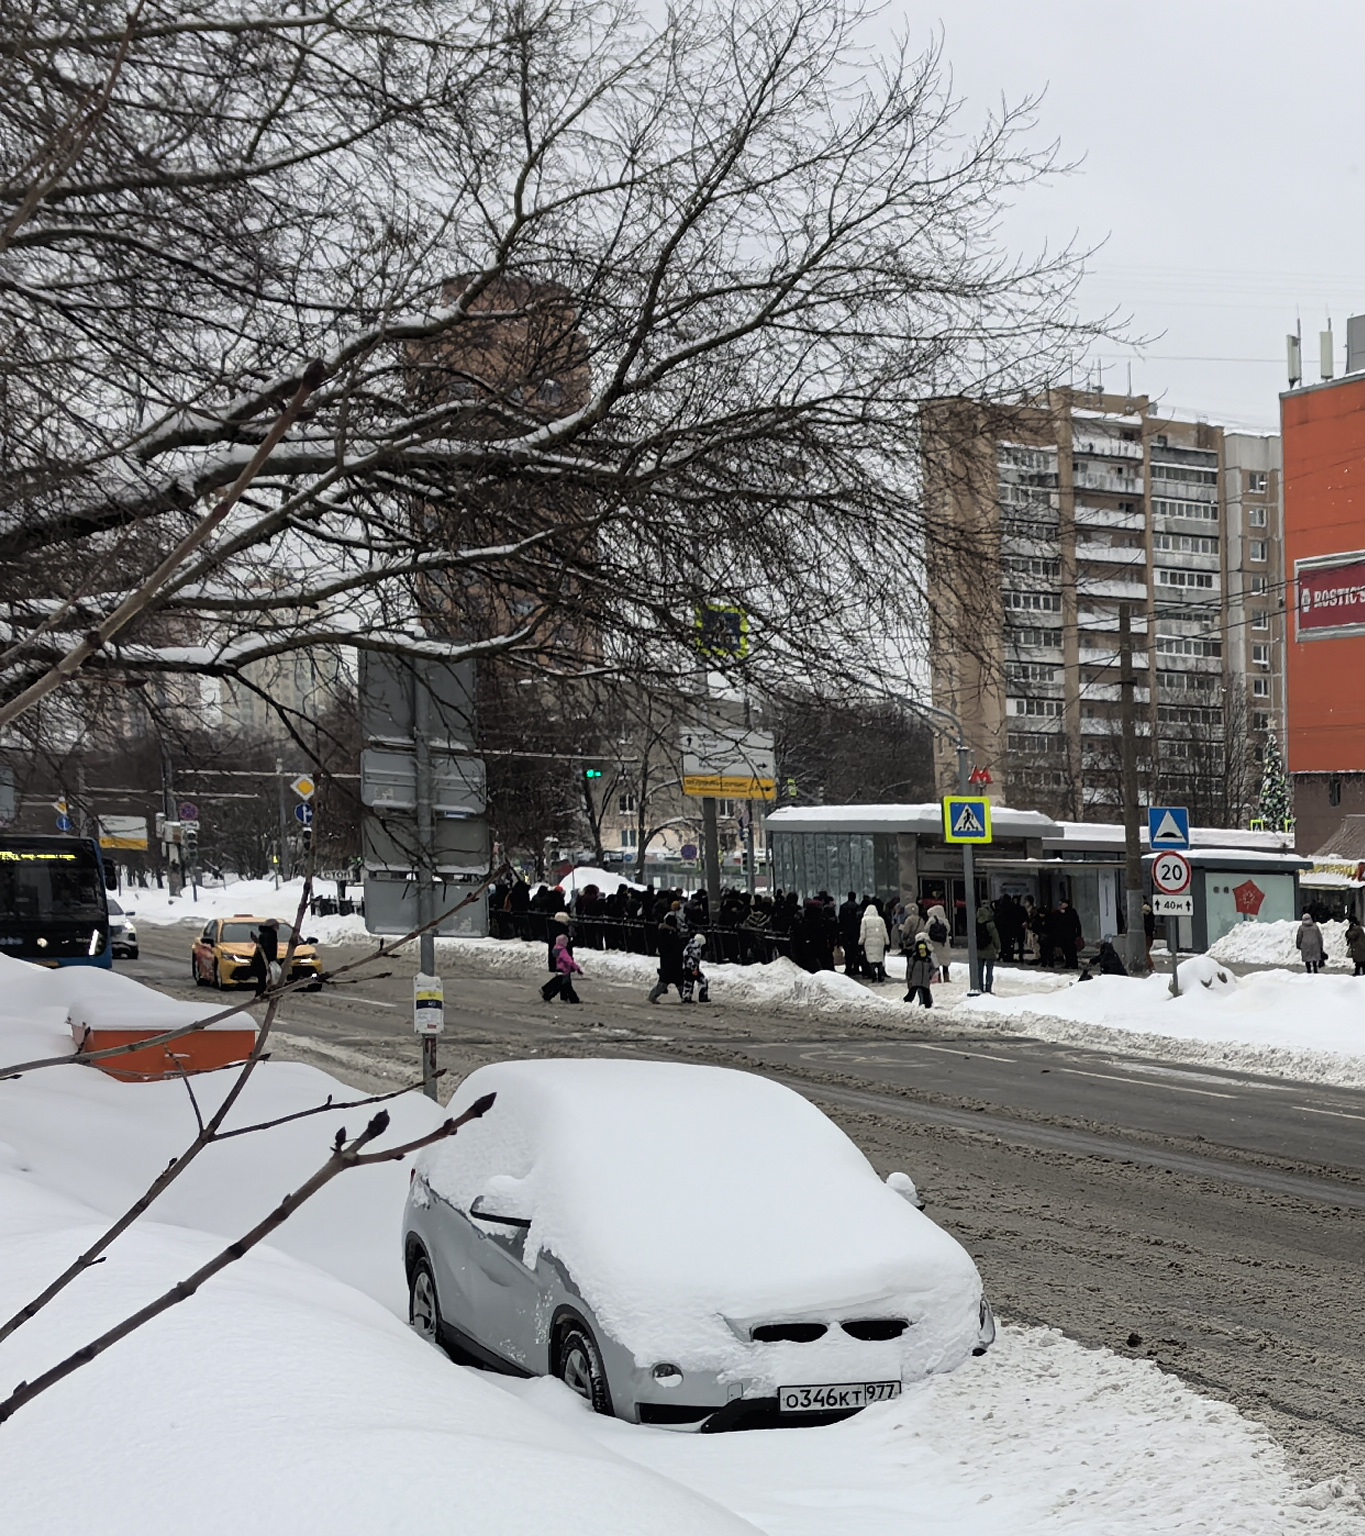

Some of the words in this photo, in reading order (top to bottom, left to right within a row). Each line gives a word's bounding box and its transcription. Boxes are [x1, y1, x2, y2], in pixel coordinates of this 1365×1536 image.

[1161, 864, 1183, 881] 20
[786, 1387, 862, 1408] О346КТ
[866, 1383, 895, 1400] 977
